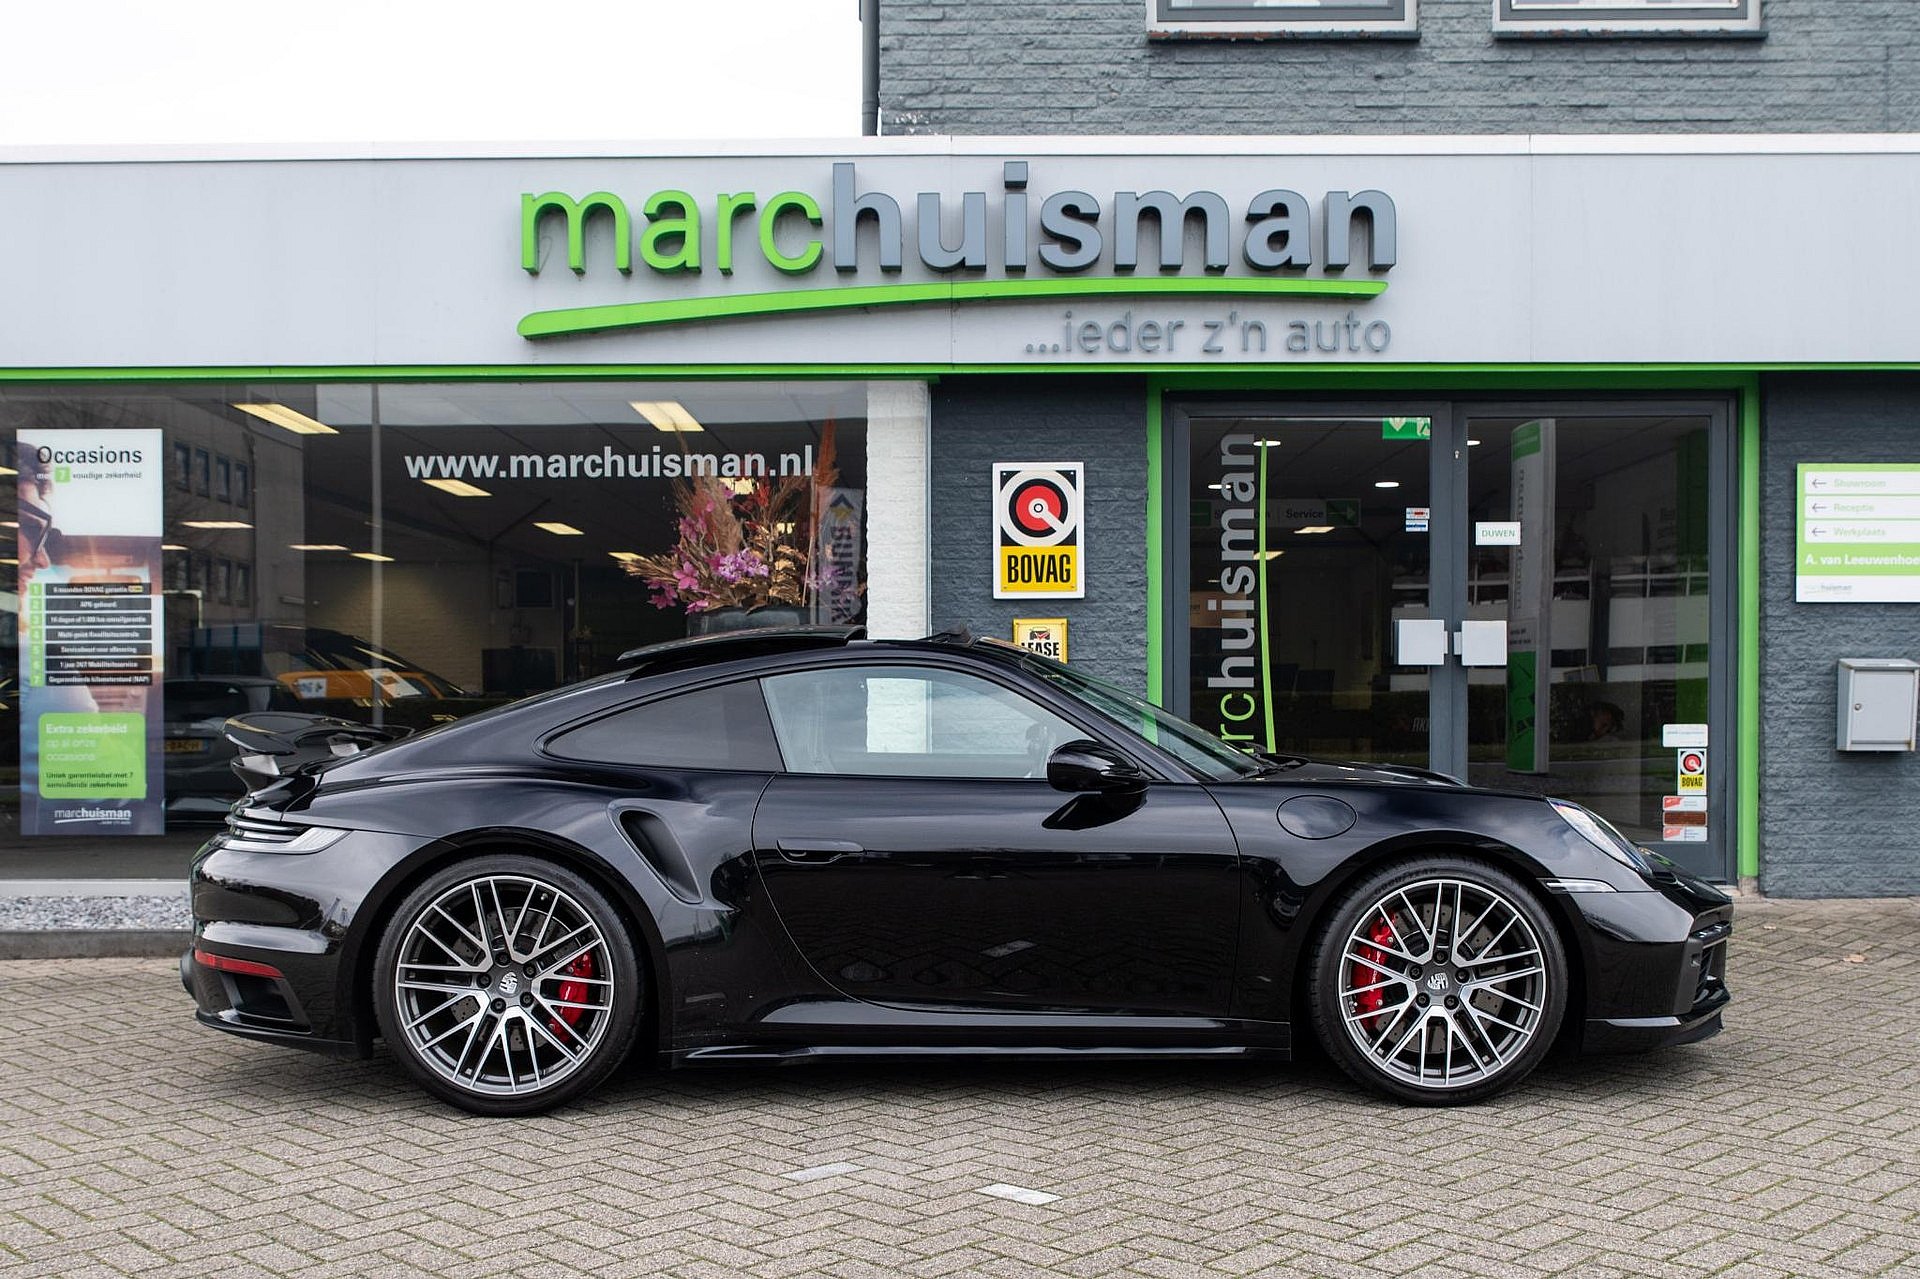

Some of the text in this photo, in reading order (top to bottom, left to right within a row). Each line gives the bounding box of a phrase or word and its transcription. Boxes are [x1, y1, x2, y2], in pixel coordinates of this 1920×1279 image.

[519, 161, 1399, 277] marchuisman
[1202, 310, 1267, 352] z'n
[1286, 310, 1392, 352] auto
[37, 446, 142, 464] Occasions
[404, 445, 813, 478] www.marchuisman.nl
[1286, 508, 1324, 519] Service
[1481, 529, 1515, 537] DUWEN
[1820, 555, 1842, 565] van
[1007, 554, 1071, 583] BOVAG
[1207, 433, 1256, 752] rchuisman
[1021, 642, 1060, 656] EASE
[1681, 776, 1703, 787] BOVAG
[54, 807, 132, 818] marchuisman
